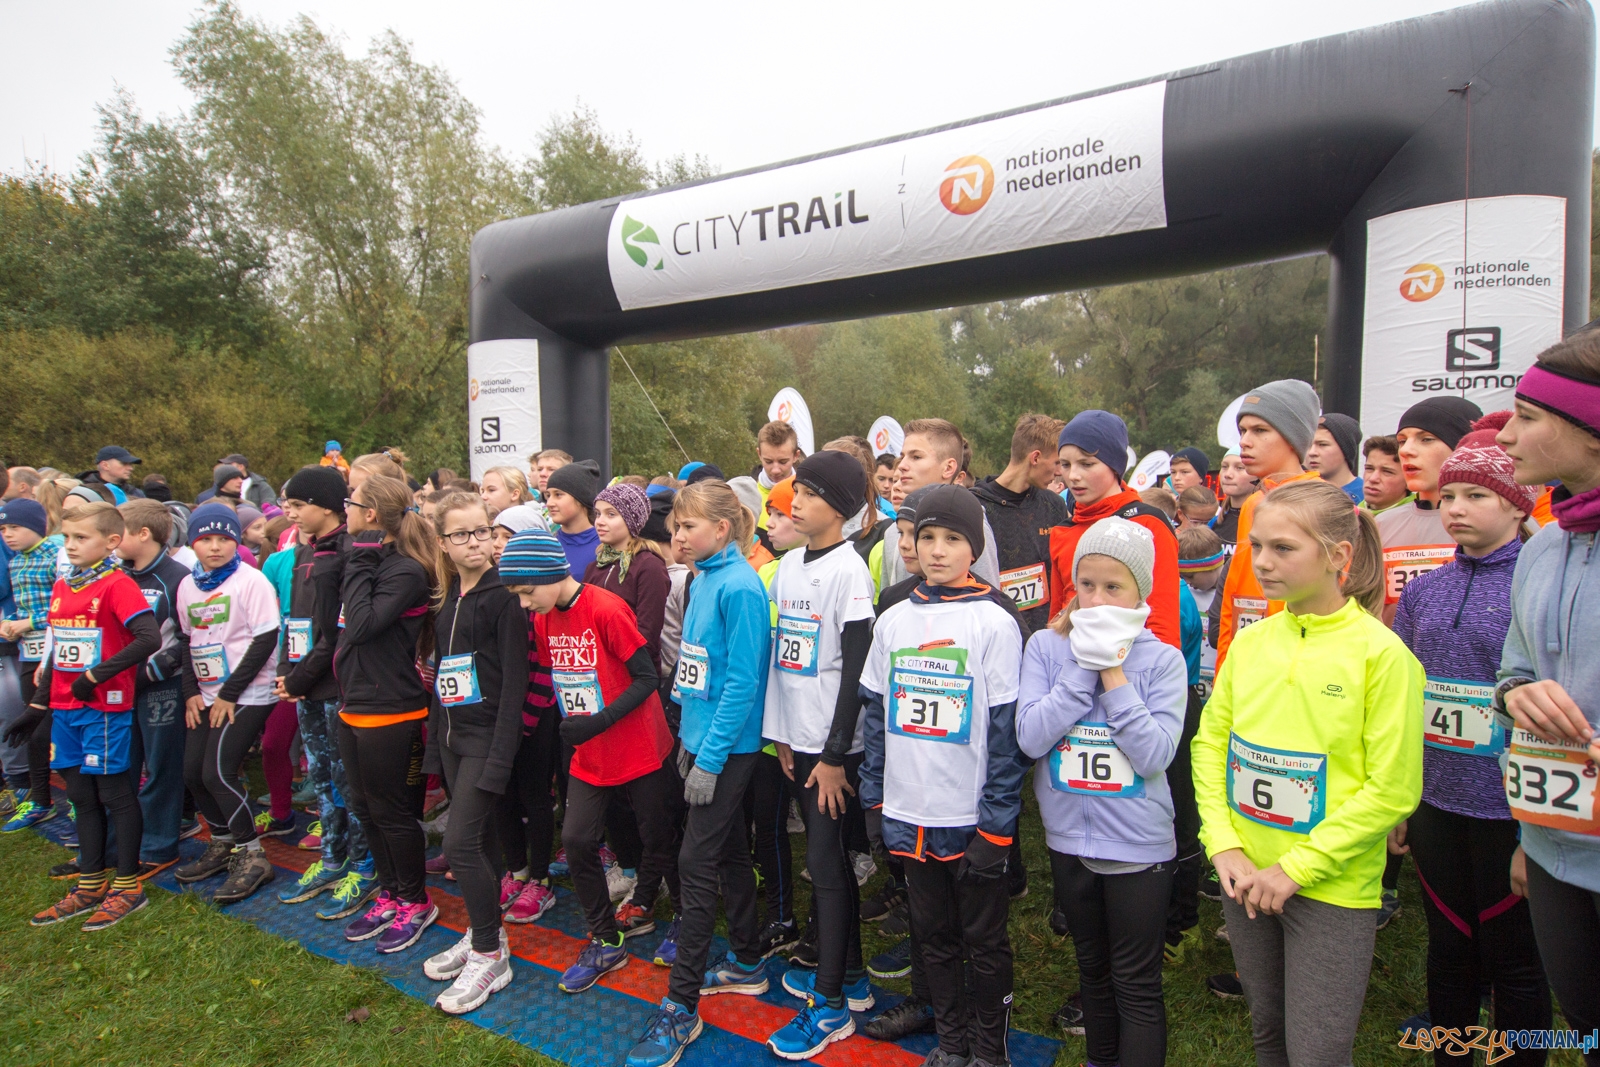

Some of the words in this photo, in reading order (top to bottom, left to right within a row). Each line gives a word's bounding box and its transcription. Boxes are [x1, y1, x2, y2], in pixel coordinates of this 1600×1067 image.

[1006, 137, 1104, 171] nationale
[1006, 154, 1141, 194] nederlanden
[1454, 259, 1531, 276] nationale
[1454, 274, 1554, 290] nederlanden
[480, 377, 512, 388] nationale
[480, 385, 526, 396] nederlanden
[1008, 582, 1037, 603] 217
[58, 645, 80, 662] 49
[782, 639, 800, 661] 28
[195, 662, 210, 677] 13
[941, 679, 965, 689] Junior
[1463, 687, 1494, 697] Junior
[147, 700, 177, 723] 32
[910, 698, 939, 727] 31
[1430, 706, 1463, 737] 41
[1077, 751, 1112, 780] 16
[1281, 758, 1314, 769] Junior
[1252, 778, 1273, 810] 6
[1508, 760, 1580, 812] 332
